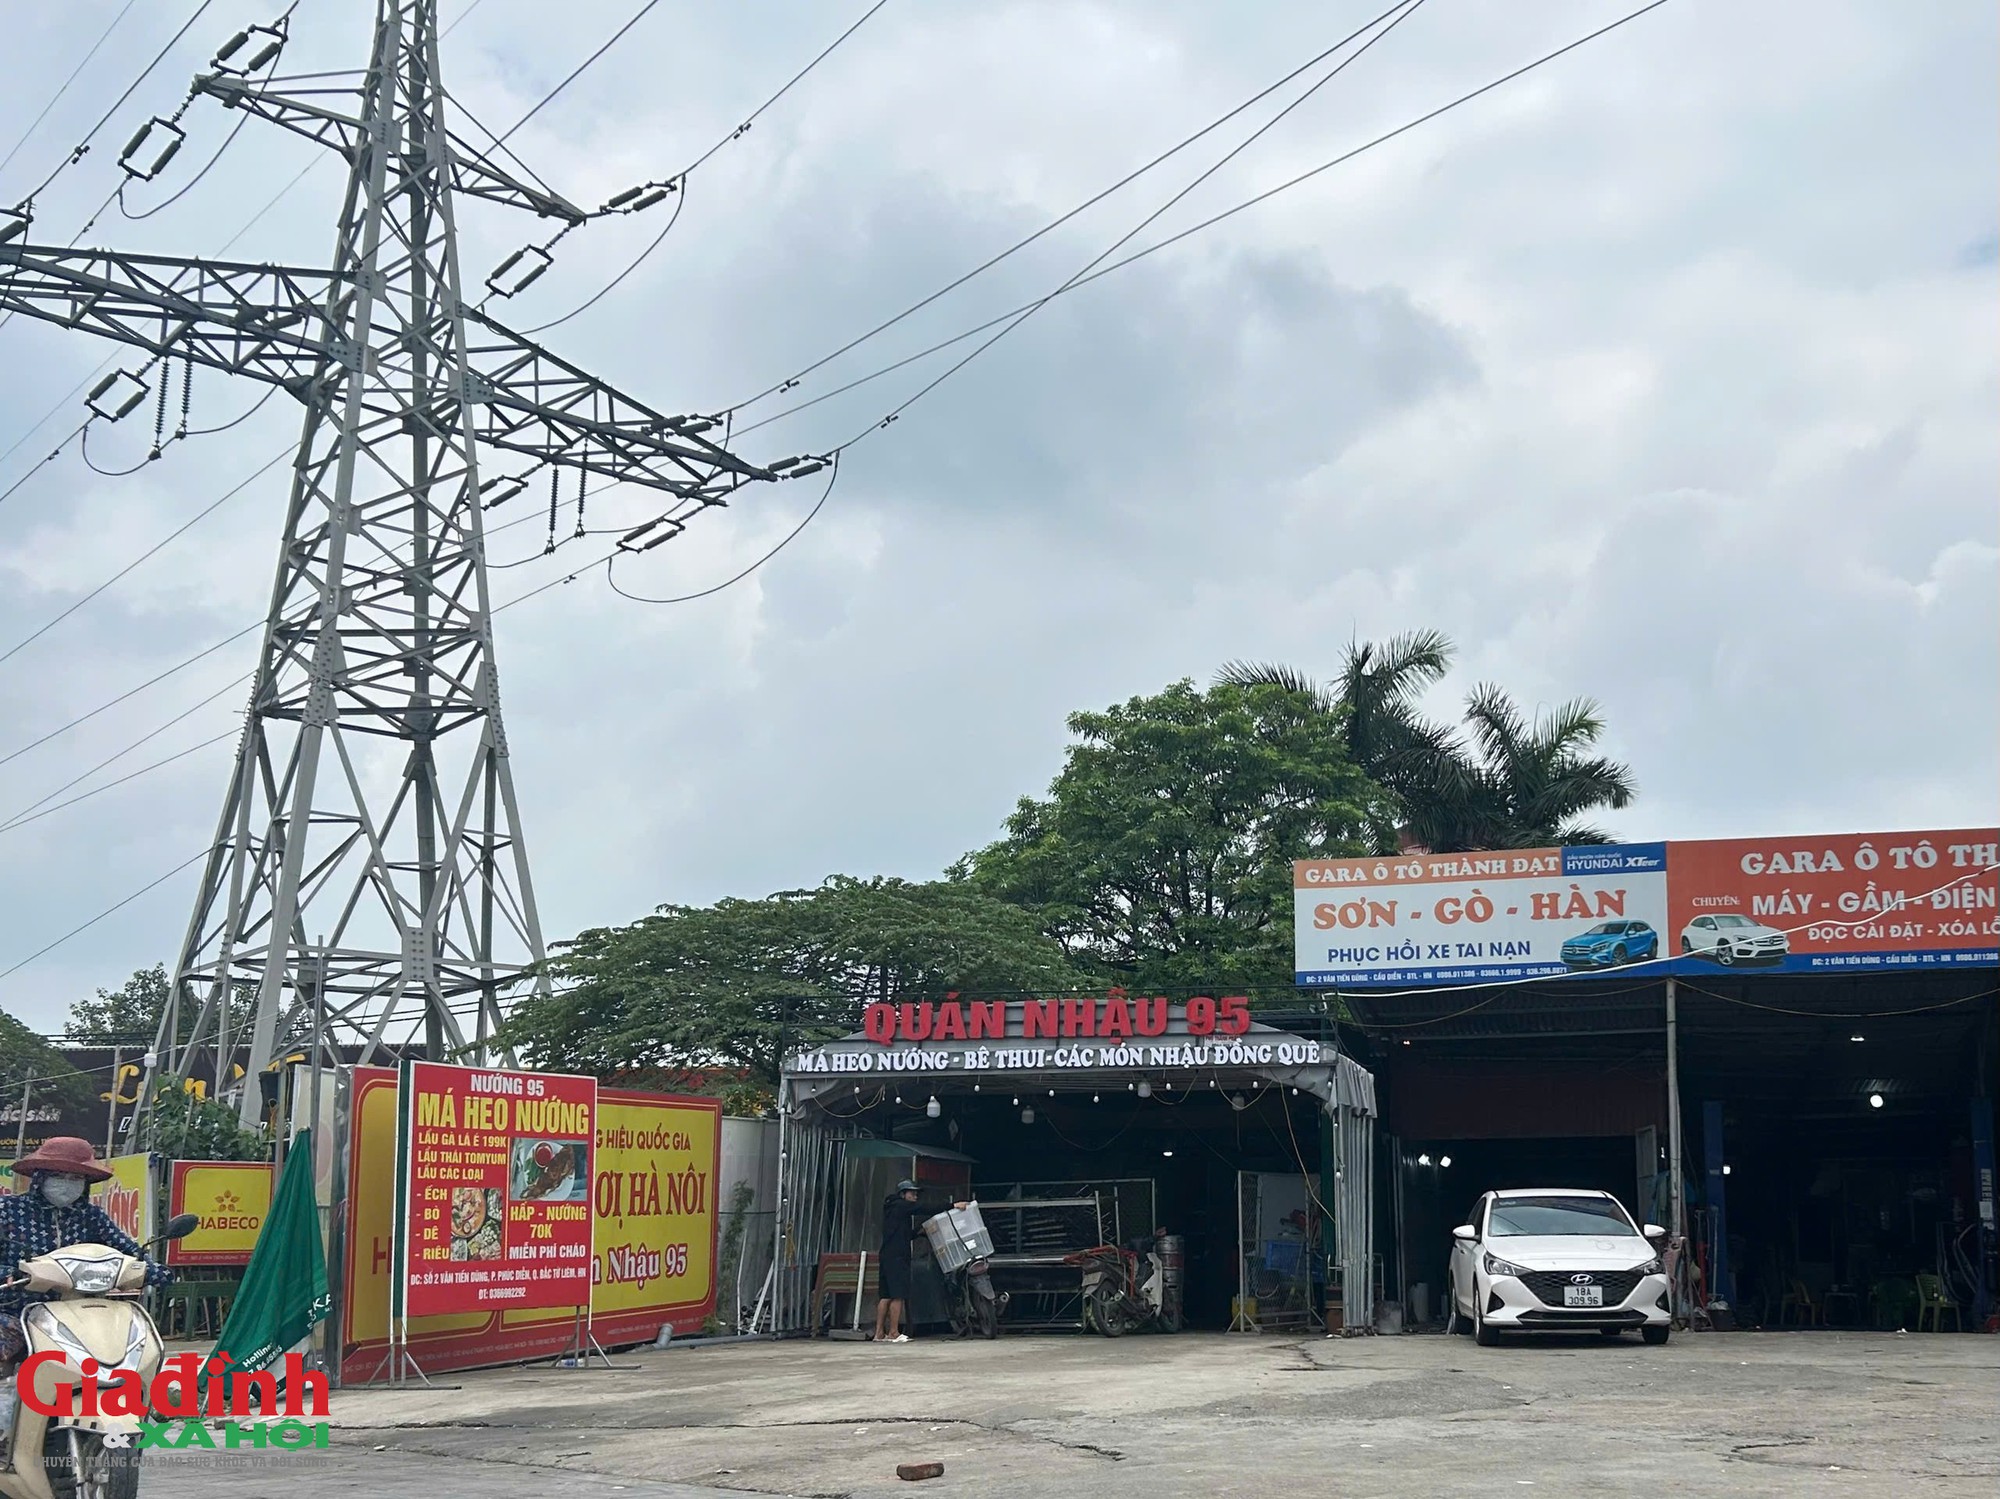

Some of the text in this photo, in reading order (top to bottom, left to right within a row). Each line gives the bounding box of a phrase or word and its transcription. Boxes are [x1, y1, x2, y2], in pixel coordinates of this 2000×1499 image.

[1567, 858, 1623, 870] HYUNDAI
[1741, 850, 1845, 875] GARA
[1854, 841, 1879, 871] Ô
[1888, 839, 1938, 870] TÔ
[1305, 857, 1560, 883] GARA Ô TÔ THÀNH ĐẠT
[1313, 896, 1398, 930] SƠN
[1434, 888, 1494, 925] GÒ
[1530, 884, 1627, 920] HÀN
[1752, 888, 1813, 916] MÁY
[1838, 880, 1905, 913] GẦM
[1931, 881, 1996, 915] ĐIỆN
[1808, 926, 1848, 944] ĐỌC
[1853, 922, 1885, 939] CÀI
[1889, 921, 1924, 941] ĐẶT
[1937, 918, 1977, 937] XÓA
[1328, 938, 1531, 966] PHỤC HỒI XE TAI NẠN
[864, 985, 1251, 1048] QUÁN NHẬU 95
[797, 1048, 830, 1073] MÁ
[831, 1052, 874, 1072] HEO
[877, 1046, 949, 1072] NƯỚNG
[963, 1045, 991, 1070] BÊ
[1099, 1042, 1144, 1067] MÓN
[1150, 1042, 1209, 1069] NHẬU
[1213, 1038, 1273, 1066] ĐỒNG
[1278, 1040, 1321, 1066] QUÊ
[470, 1073, 545, 1097] NƯỚNG 95
[418, 1087, 589, 1135] MÁ HEO NƯỚNG
[441, 1131, 455, 1147] GÀ
[458, 1131, 470, 1147] LÁ
[483, 1135, 507, 1148] 199K
[606, 1124, 634, 1154] HIỆU
[636, 1122, 670, 1151] QUỐC
[672, 1131, 691, 1151] GIA
[440, 1149, 461, 1164] THÁI
[464, 1152, 507, 1165] TOMYUM
[440, 1166, 460, 1180] CÁC
[462, 1168, 484, 1182] LOẠI
[424, 1185, 447, 1200] ẾCH
[627, 1159, 662, 1217] HÀ
[423, 1204, 440, 1220] BÒ
[510, 1201, 535, 1221] HẤP
[546, 1204, 587, 1221] NƯỚNG
[423, 1225, 439, 1240] DÊ
[530, 1223, 553, 1239] 70K
[422, 1244, 450, 1260] RIÊU
[509, 1241, 586, 1259] MIỄN PHÍ CHÁO
[607, 1242, 660, 1290] Nhậu
[665, 1243, 689, 1278] 95
[434, 1273, 439, 1284] 2
[1576, 1287, 1592, 1296] 18A
